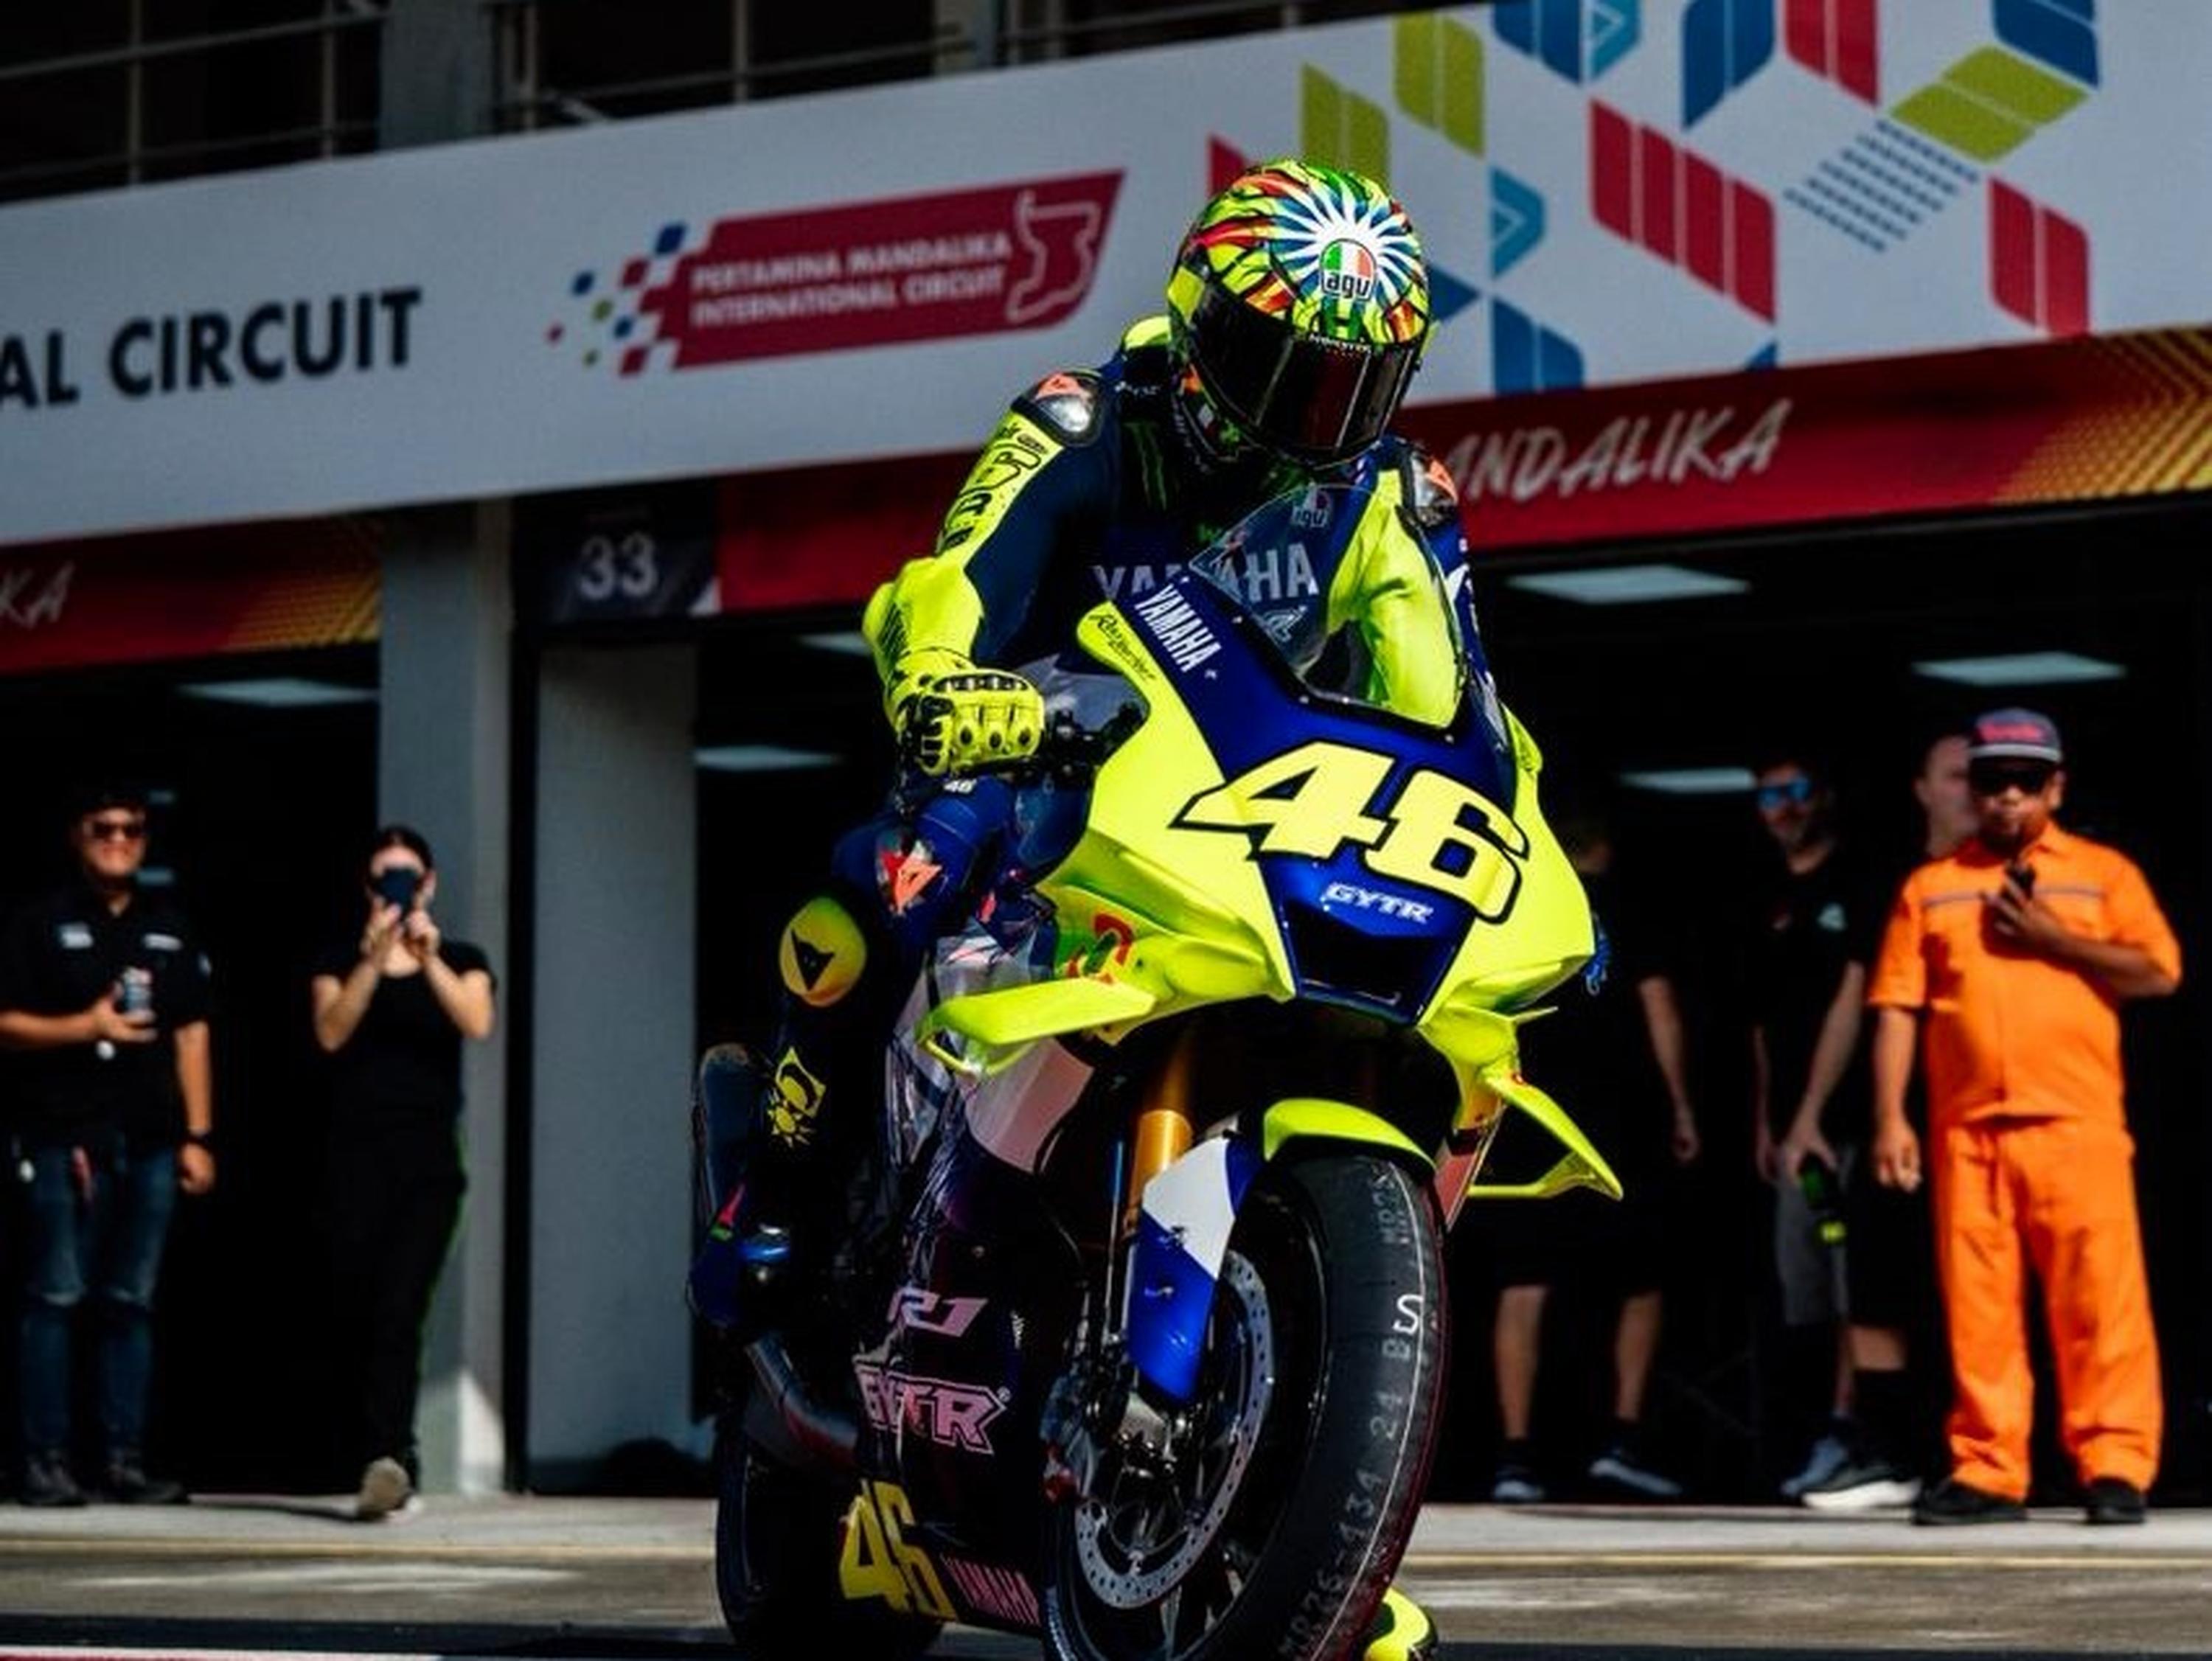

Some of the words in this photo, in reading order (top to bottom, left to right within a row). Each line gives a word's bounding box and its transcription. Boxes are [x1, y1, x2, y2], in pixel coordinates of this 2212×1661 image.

[691, 251, 841, 292] PERTAMINA
[846, 231, 1011, 274] MANDALIKA
[1326, 271, 1371, 299] agv
[690, 279, 898, 327] INTERNATIONAL
[902, 264, 1007, 304] CIRCUIT
[108, 286, 422, 399] CIRCUIT
[580, 532, 657, 601] 33
[1134, 582, 1222, 673] YAMAHA
[1168, 740, 1529, 925] 46
[1325, 882, 1435, 925] GYTR
